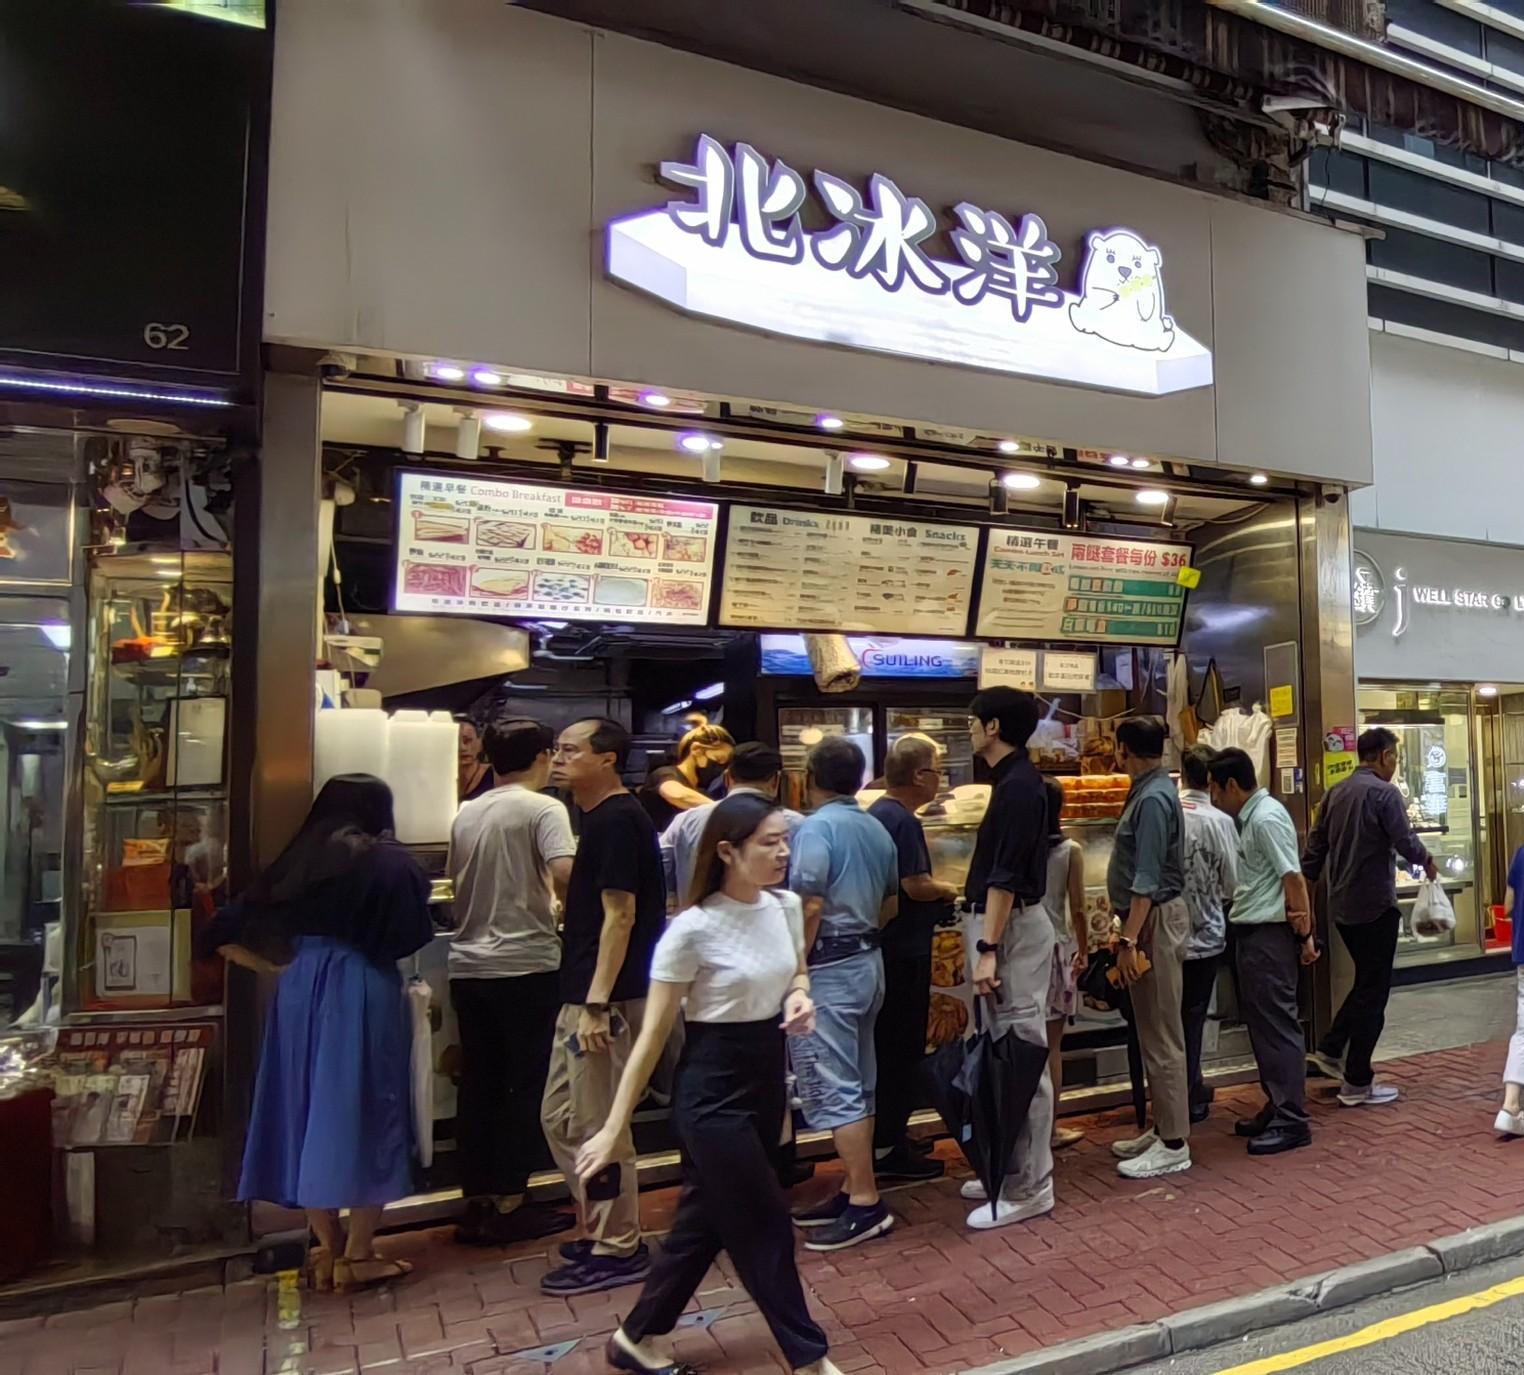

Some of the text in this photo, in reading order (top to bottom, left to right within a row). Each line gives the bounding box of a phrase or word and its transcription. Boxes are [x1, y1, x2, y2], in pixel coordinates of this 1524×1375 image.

[661, 133, 1065, 323] 北冰洋
[144, 322, 190, 350] 62
[470, 486, 509, 498] Combo
[512, 489, 561, 503] Breakfast
[925, 529, 966, 541] Snacks
[1161, 552, 1186, 567] $36
[1412, 586, 1451, 605] WELL
[1454, 588, 1489, 608] STAR
[872, 654, 943, 667] SUILING
